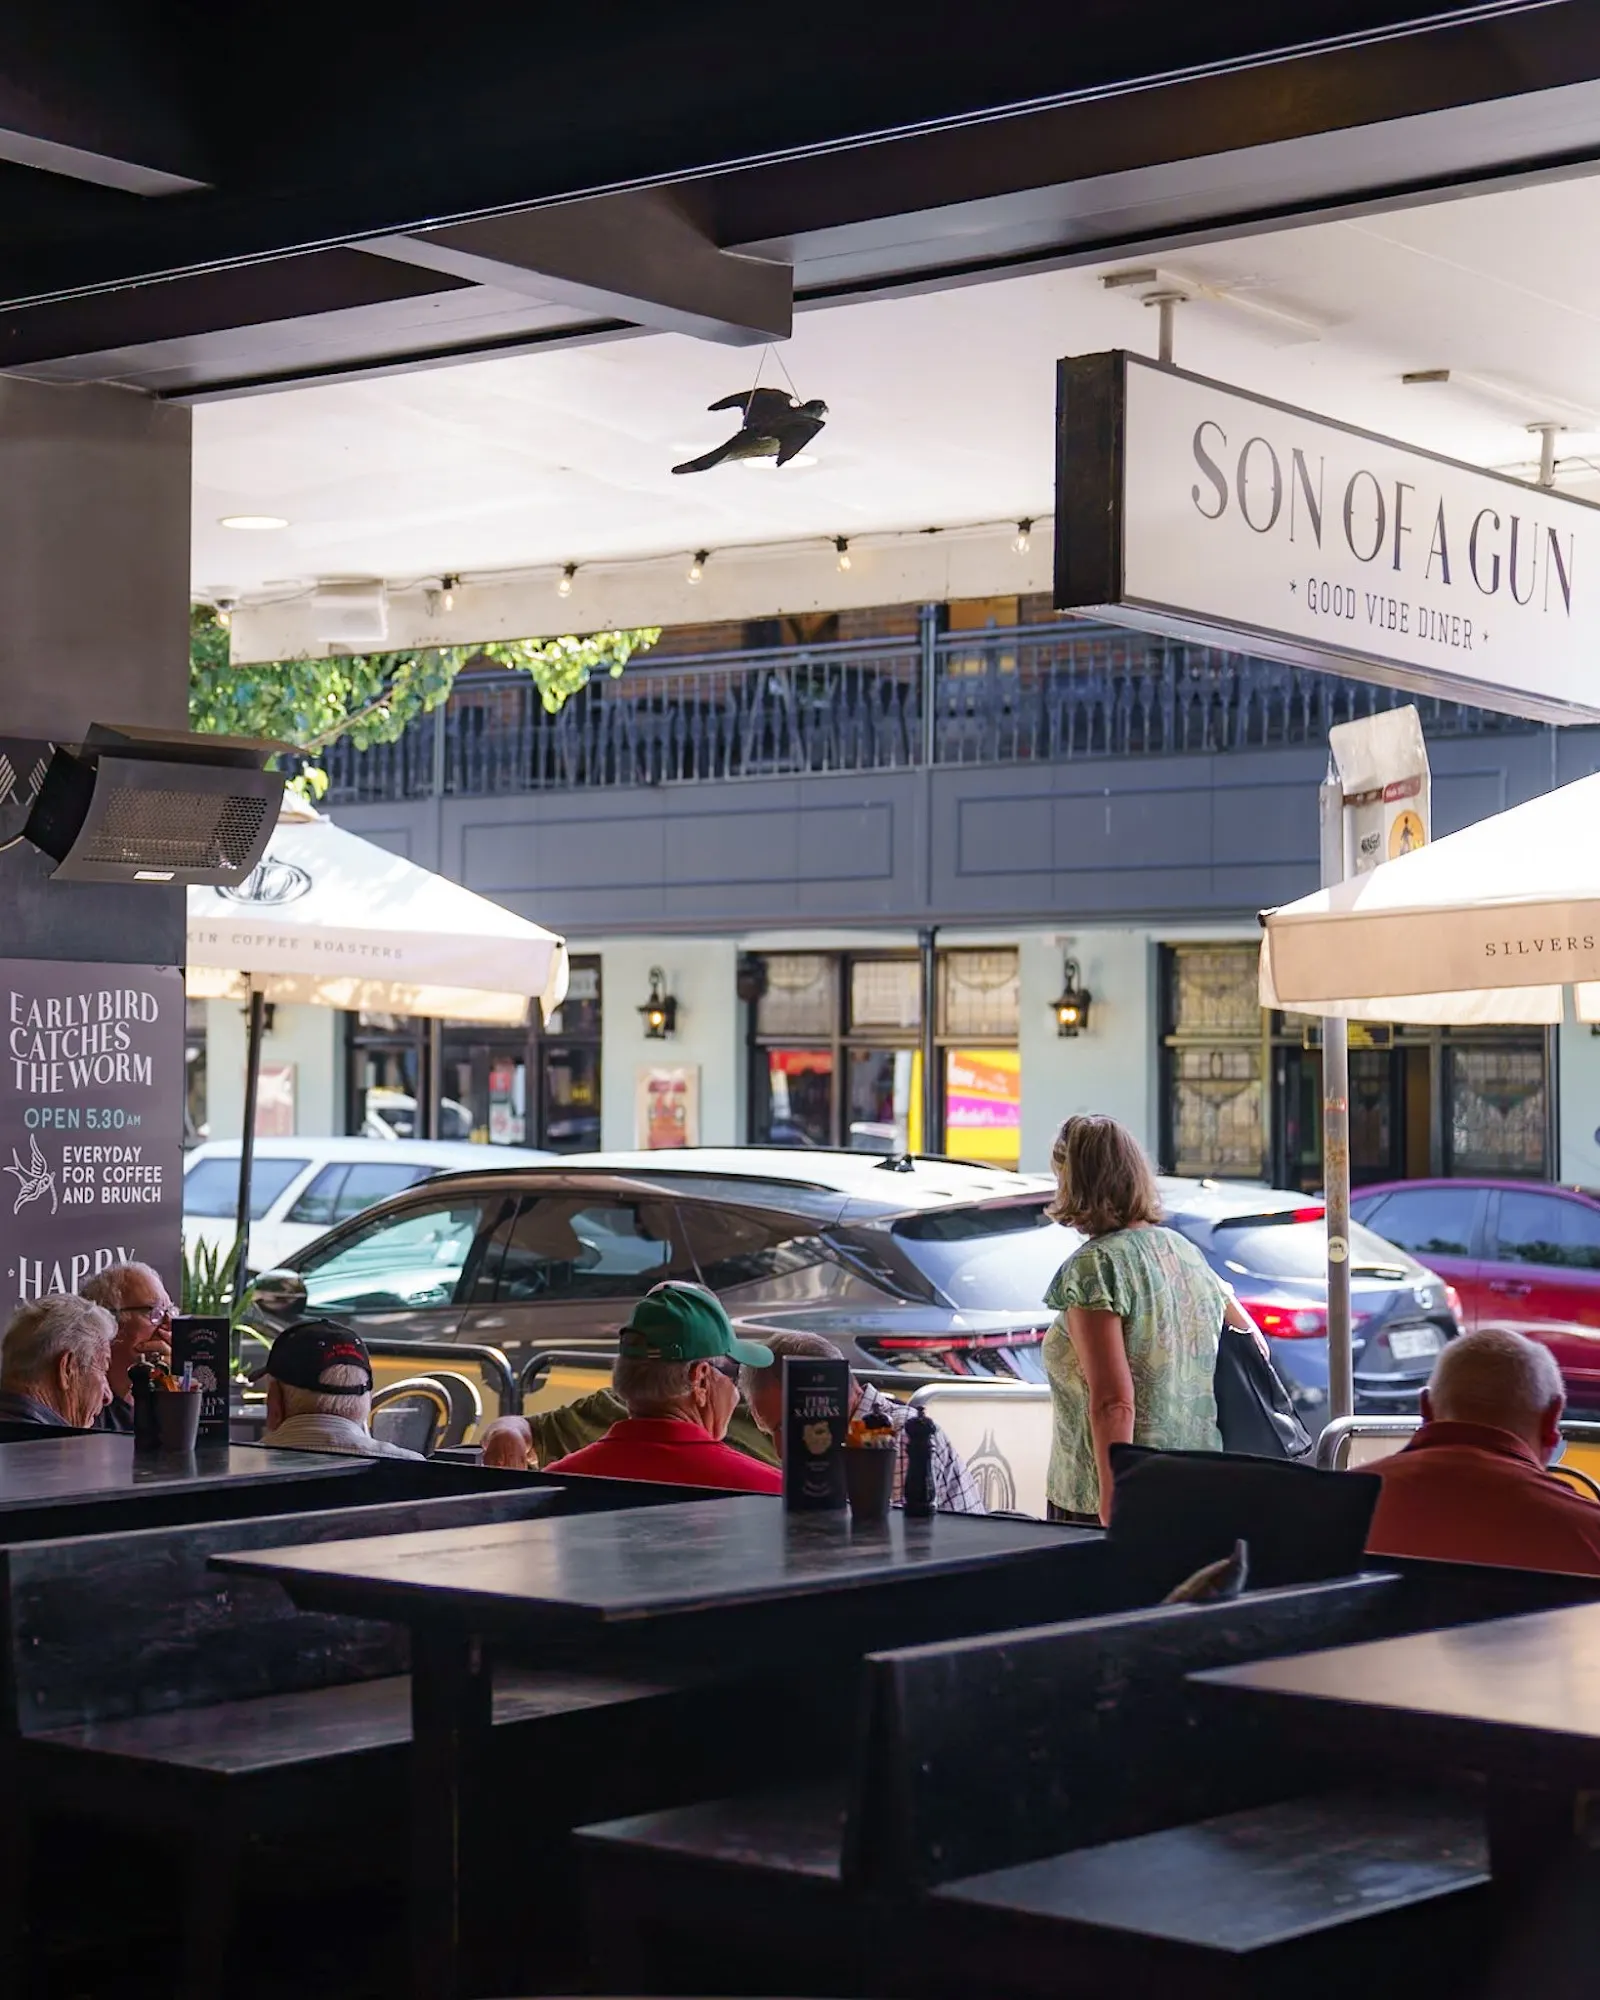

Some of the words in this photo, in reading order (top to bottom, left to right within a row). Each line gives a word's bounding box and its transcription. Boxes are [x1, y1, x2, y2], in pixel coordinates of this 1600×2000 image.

[1191, 420, 1325, 551] SON
[1343, 469, 1416, 572] OF
[1424, 494, 1453, 586] A
[1468, 508, 1575, 619] GUN
[1306, 577, 1356, 621] GOOD
[1366, 592, 1410, 634] VIBE
[1418, 607, 1473, 651] DINER
[231, 933, 299, 950] COFFEE
[313, 939, 404, 959] ROASTERS
[1485, 935, 1595, 957] SILVERS
[9, 990, 93, 1030] EARLY
[98, 989, 159, 1024] BIRD
[9, 1021, 131, 1062] CATCHES
[10, 1056, 64, 1094] THE
[69, 1053, 153, 1090] WORM
[24, 1107, 80, 1130] OPEN
[62, 1146, 142, 1164] EVERYDAY
[62, 1166, 95, 1184] FOR
[103, 1166, 163, 1184] COFFEE
[62, 1187, 95, 1204] AND
[101, 1186, 162, 1204] BRUNCH
